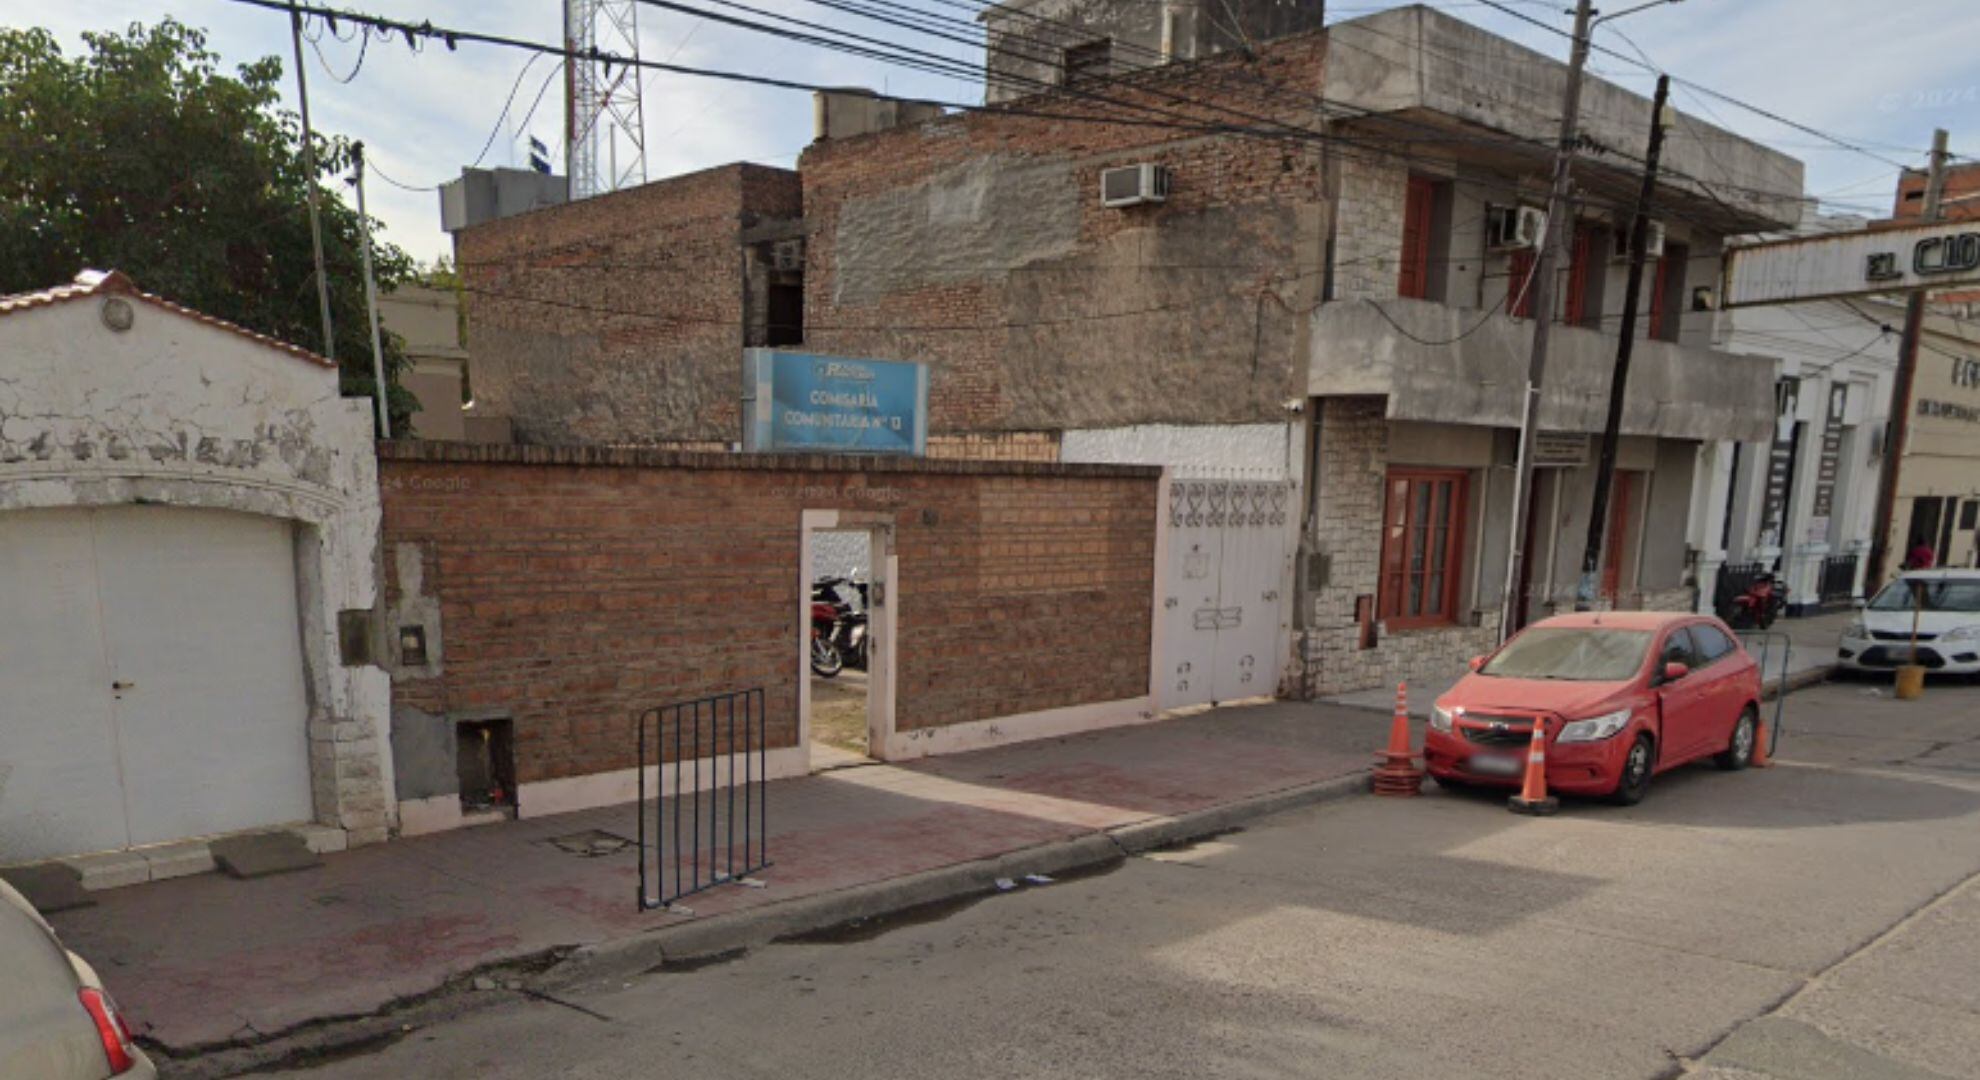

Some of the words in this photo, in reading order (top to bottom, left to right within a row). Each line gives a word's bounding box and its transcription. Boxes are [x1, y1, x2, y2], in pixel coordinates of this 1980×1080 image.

[1866, 251, 1903, 280] EL
[809, 389, 878, 408] COMISARÍA
[784, 410, 869, 429] COMUNITARIA
